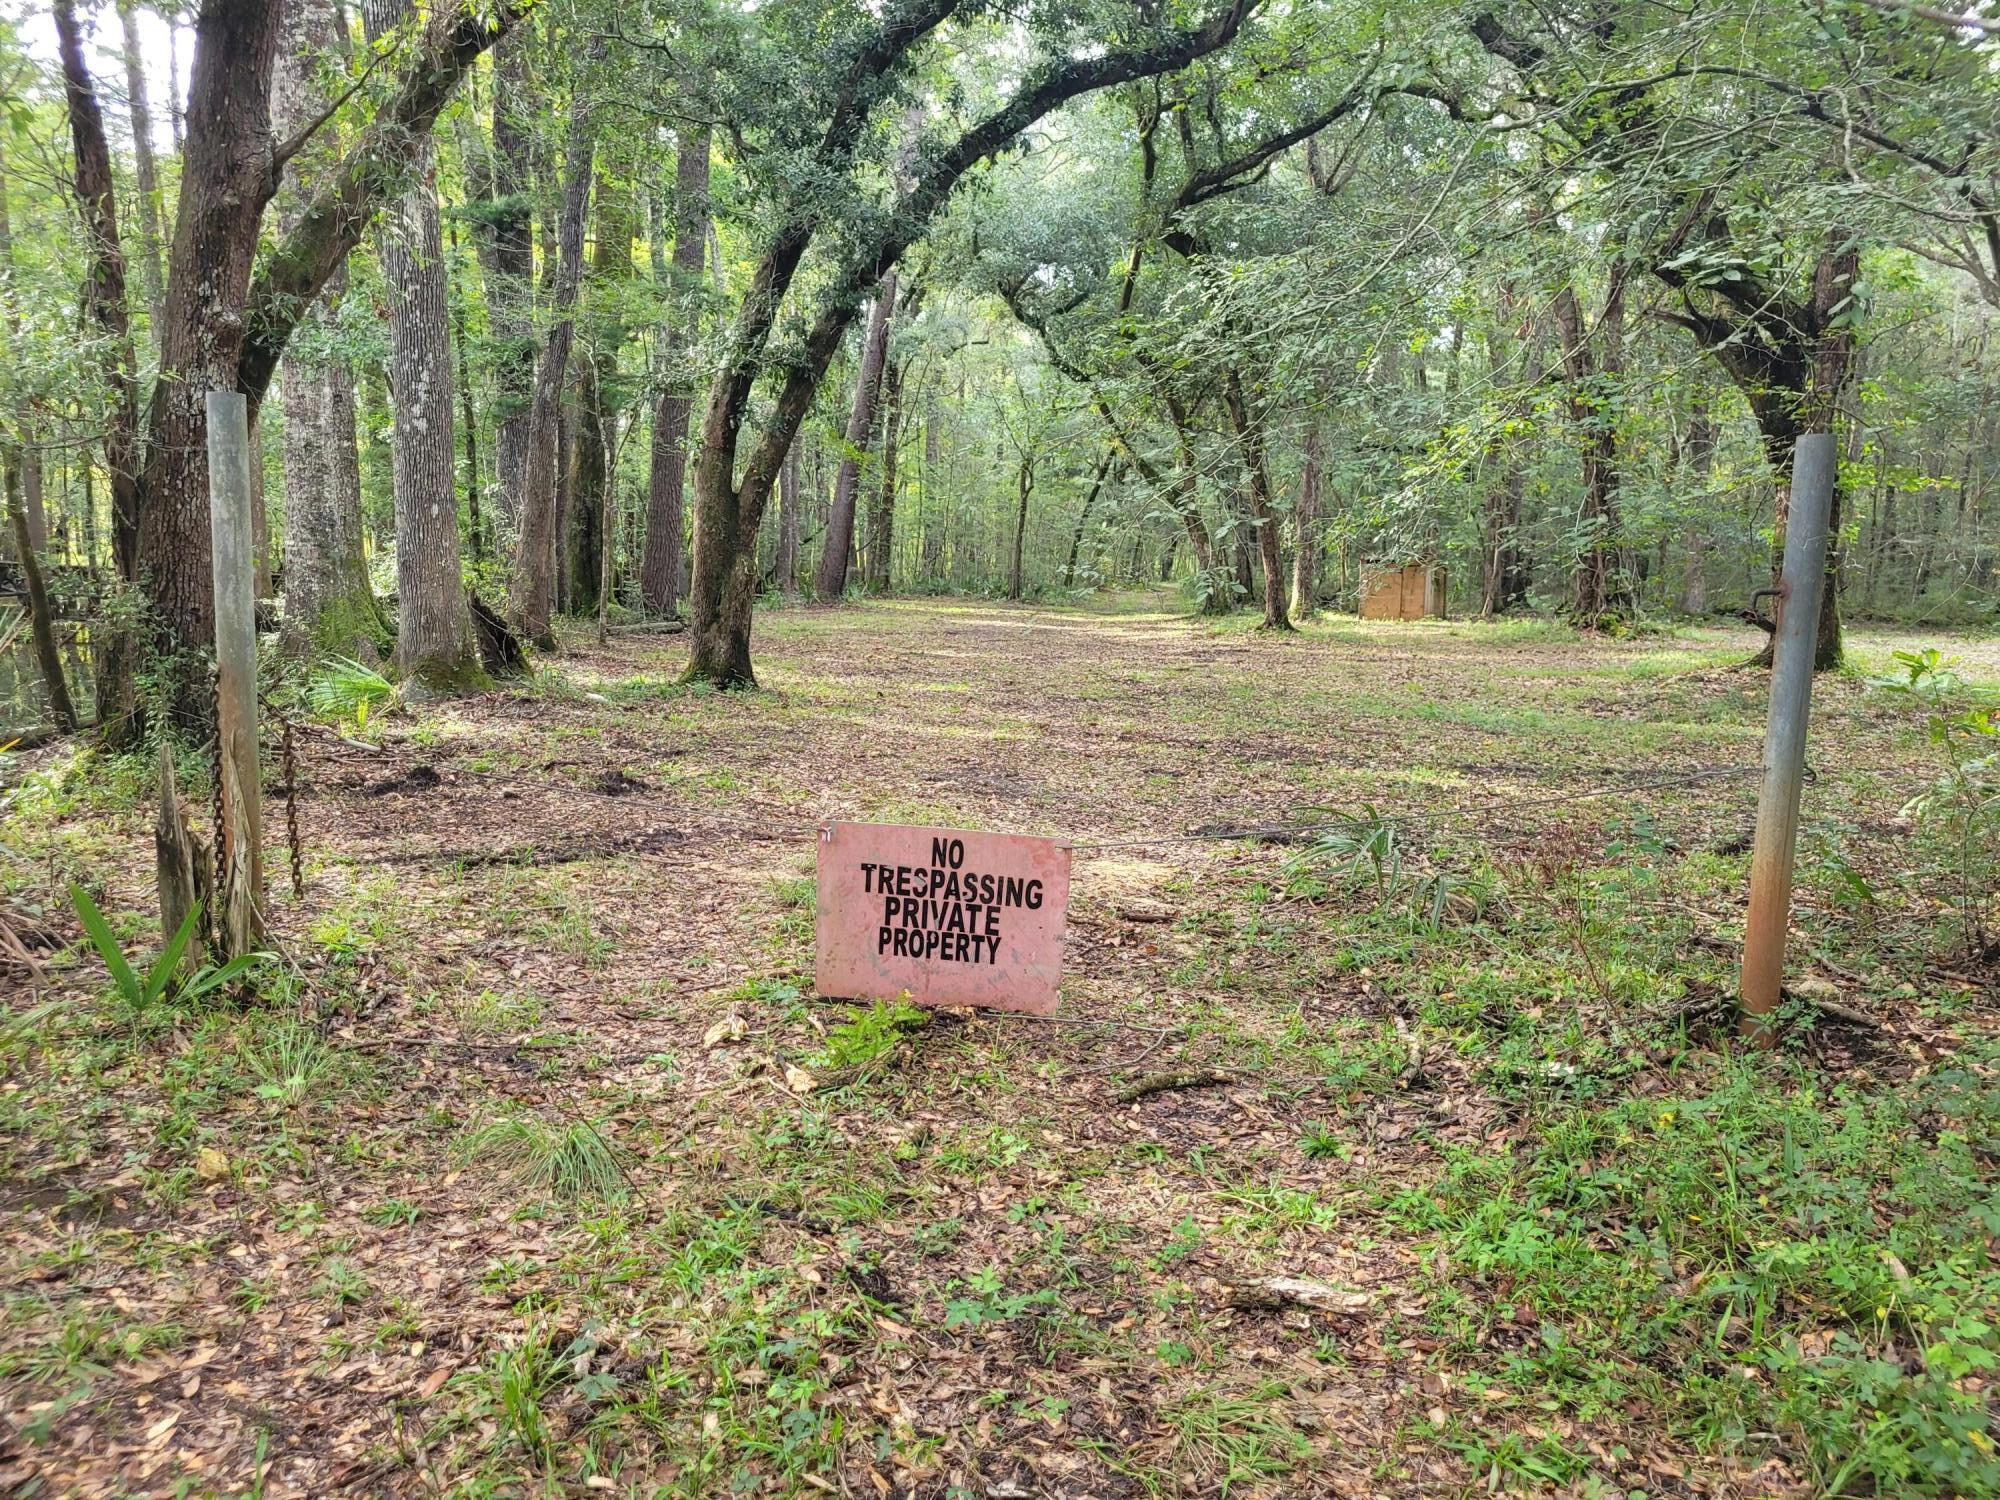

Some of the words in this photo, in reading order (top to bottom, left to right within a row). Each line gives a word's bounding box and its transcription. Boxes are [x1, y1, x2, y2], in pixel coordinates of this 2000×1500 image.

[931, 837, 964, 869] NO
[861, 863, 1043, 909] TRESPASSING
[884, 896, 1000, 936] PRIVATE
[879, 927, 1001, 964] PROPERTY
